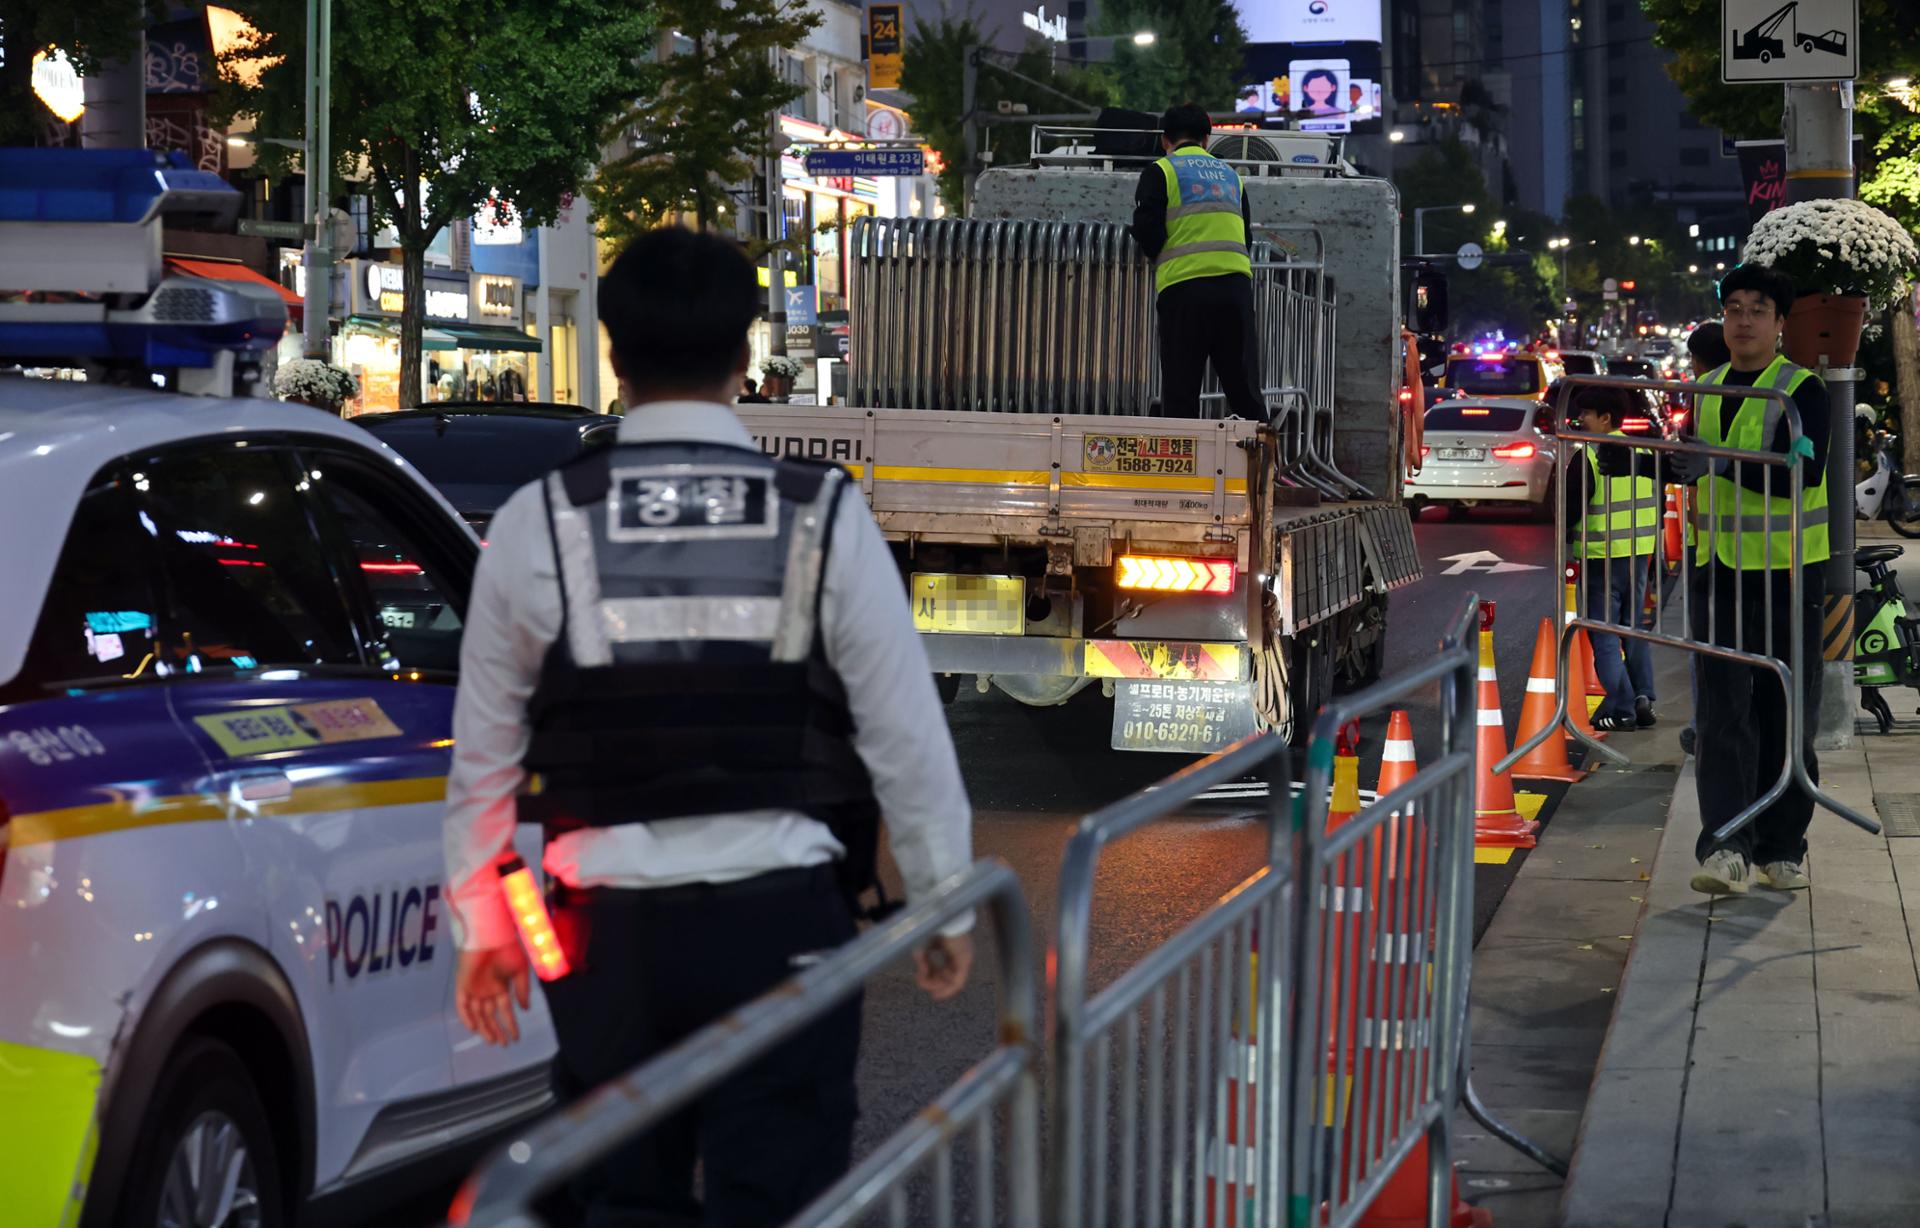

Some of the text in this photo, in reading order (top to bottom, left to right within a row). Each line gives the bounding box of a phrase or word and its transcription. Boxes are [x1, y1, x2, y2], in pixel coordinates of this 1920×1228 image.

[874, 20, 897, 39] 24
[855, 153, 921, 167] 이태원로23길
[1187, 158, 1227, 170] POLICE
[1198, 170, 1227, 181] LINE
[752, 436, 861, 460] UNDAI
[1116, 457, 1193, 473] 1588-7924
[638, 479, 748, 525] 경찰
[325, 885, 439, 984] POLICE
